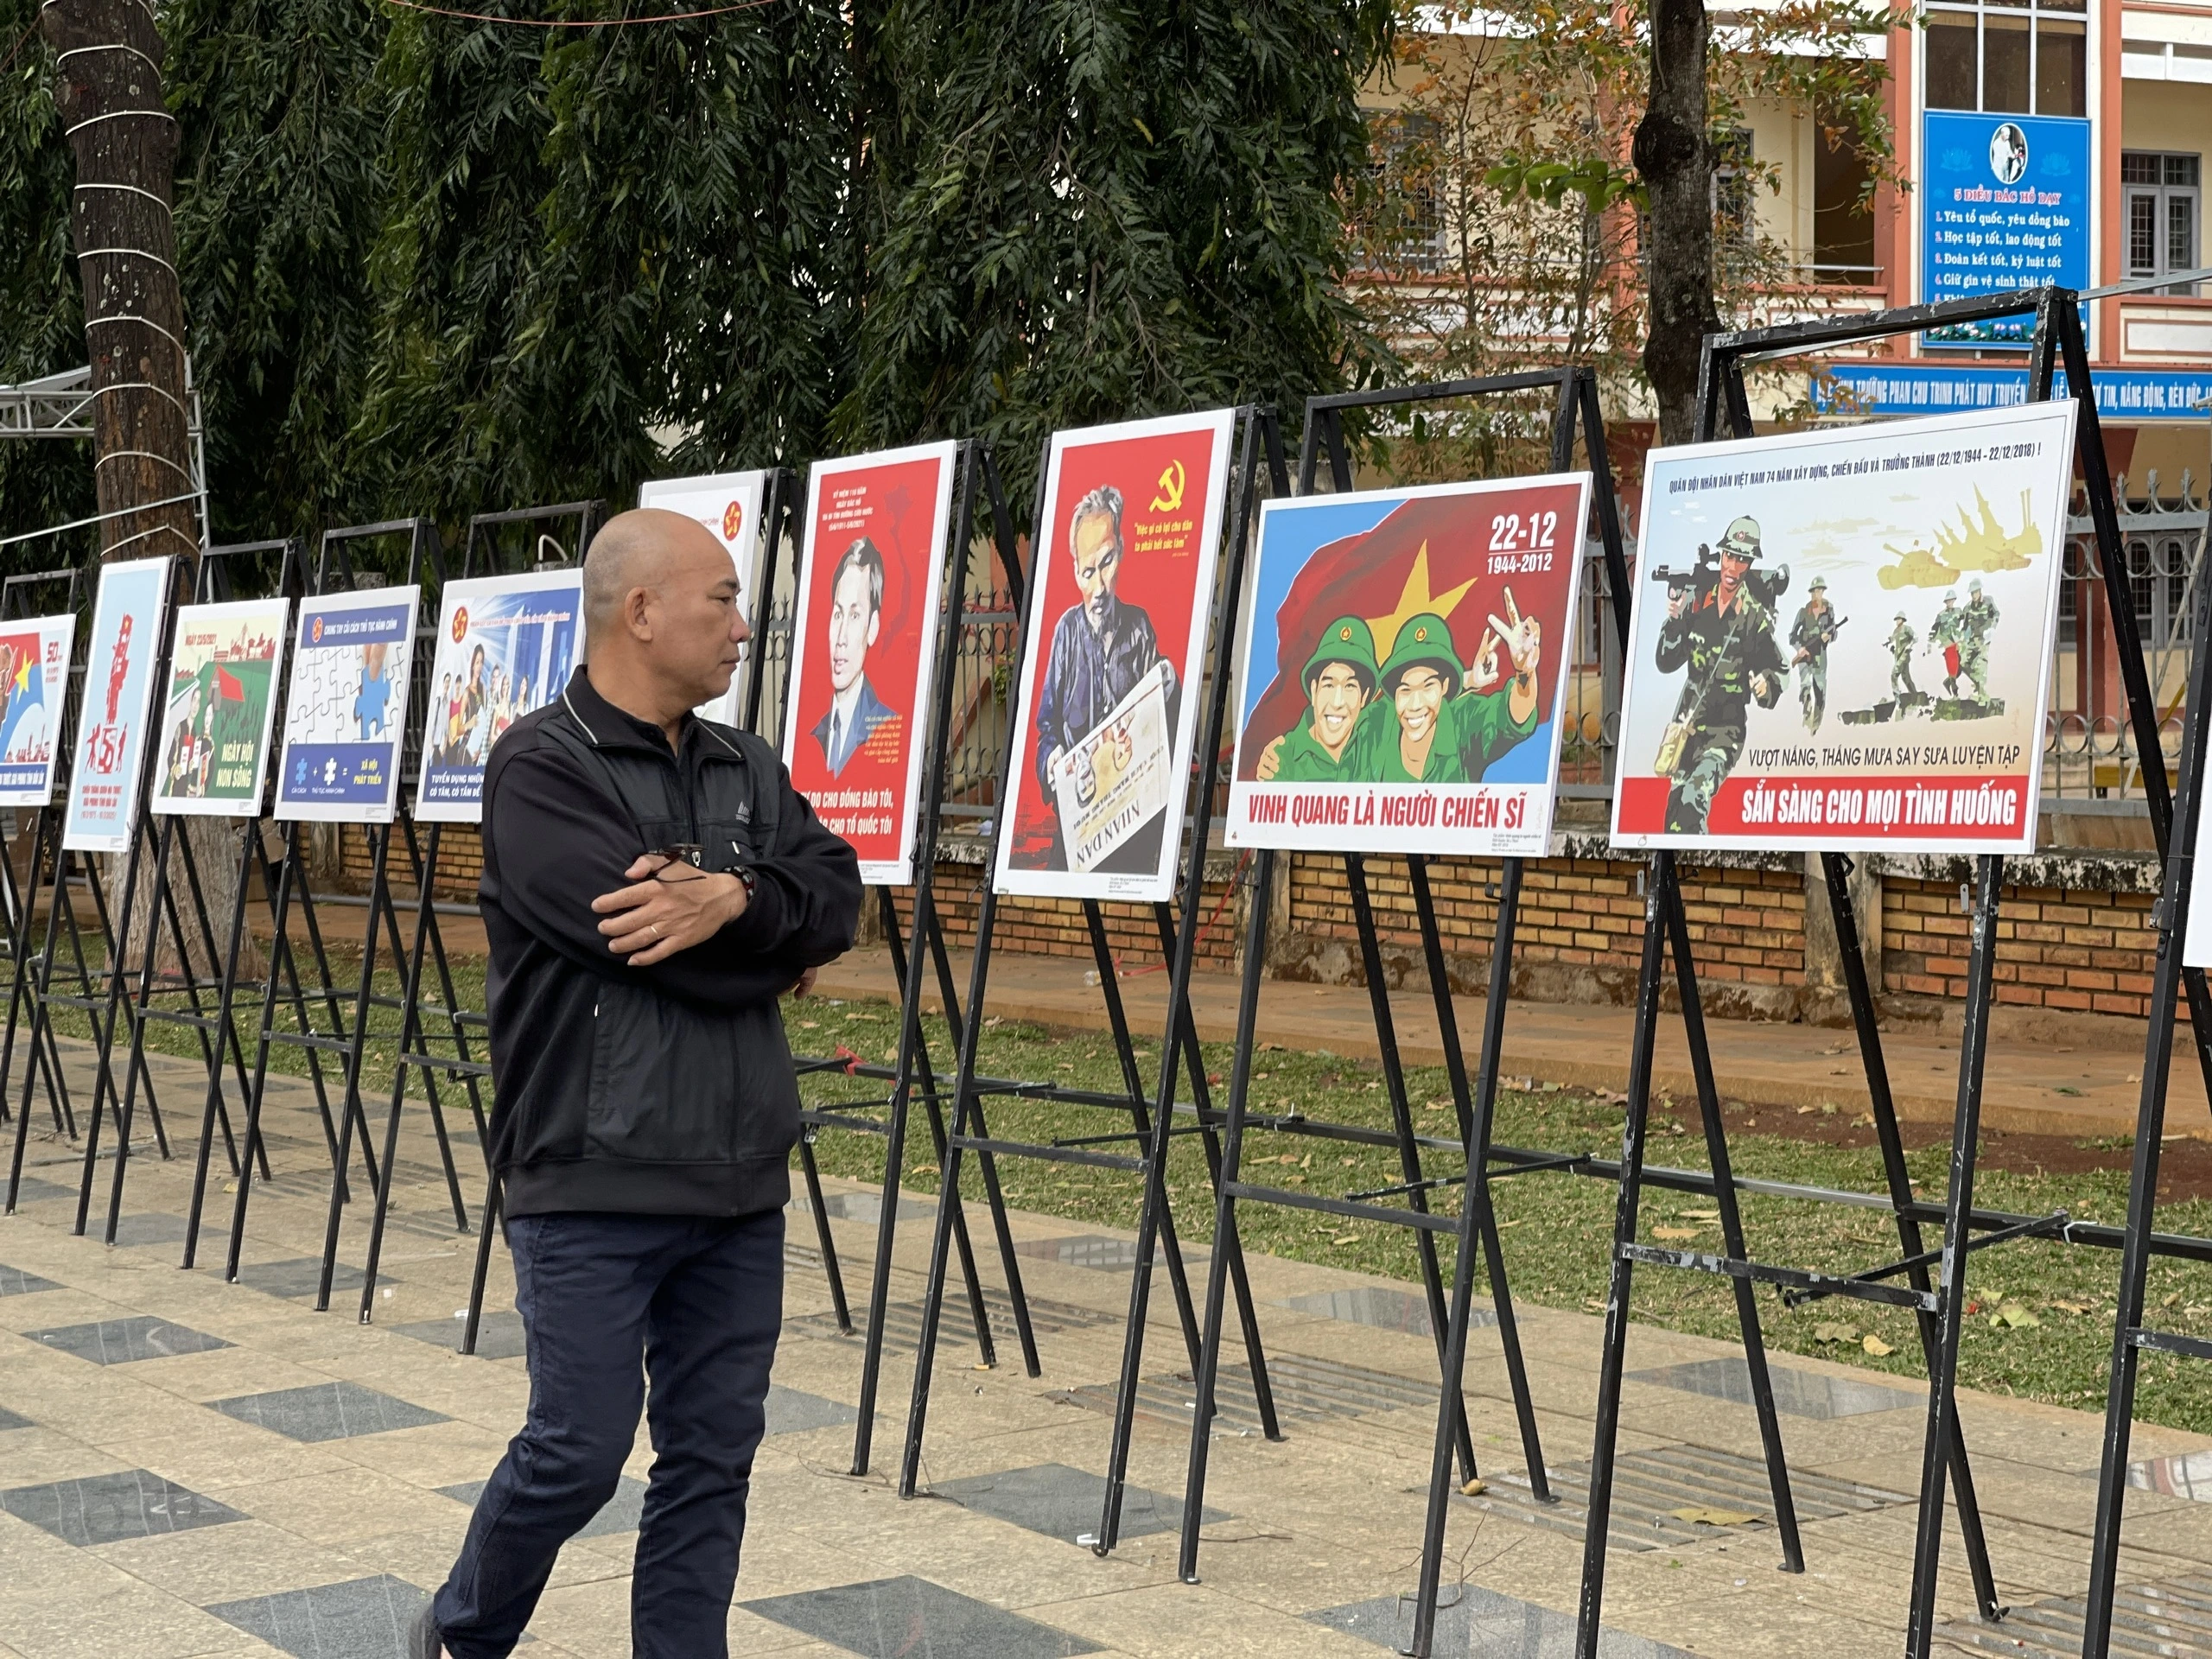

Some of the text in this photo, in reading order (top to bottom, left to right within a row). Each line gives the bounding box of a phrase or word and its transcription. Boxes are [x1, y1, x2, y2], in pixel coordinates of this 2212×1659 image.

[1954, 188, 1962, 201] 5
[1994, 188, 2018, 203] BÁC
[2019, 185, 2036, 204] HỒ
[1936, 211, 1942, 222] 1.
[1944, 211, 1963, 223] Yêu
[1966, 208, 1976, 223] tổ
[1979, 210, 2005, 226] quốc,
[2008, 213, 2026, 227] yêu
[2053, 214, 2070, 226] bào
[1935, 231, 1942, 243] 2.
[1944, 231, 1963, 245] Học
[1966, 232, 1983, 247] tập
[1986, 231, 2003, 246] tốt,
[2005, 232, 2020, 245] lao
[2048, 232, 2063, 247] tốt
[1944, 252, 1969, 264] Đoàn
[1972, 251, 1988, 265] kết
[1991, 252, 2009, 267] tốt,
[2026, 255, 2044, 270] luật
[2047, 254, 2062, 268] tốt
[1943, 273, 1962, 285] Giữ
[1981, 274, 1993, 289] vệ
[1995, 274, 2016, 287] sinh
[1889, 380, 1910, 404] PHAN
[1912, 381, 1928, 404] CHU
[1930, 381, 1953, 405] TRINH
[1955, 378, 1976, 405] PHÁT
[1977, 383, 1993, 405] HUY
[2104, 385, 2118, 410] TIN,
[2120, 381, 2142, 409] NĂNG
[2143, 380, 2166, 413] ĐỘNG,
[2168, 381, 2184, 408] RÈN
[1669, 479, 1686, 494] QUÂN
[1688, 478, 1699, 494] ĐỘI
[1700, 475, 1718, 491] NHÂN
[1719, 473, 1732, 488] DÂN
[1733, 471, 1749, 490] VIỆT
[1750, 471, 1765, 486] NAM
[1766, 471, 1776, 483] 74
[1777, 467, 1792, 482] NĂM
[1794, 465, 1808, 480] XÂY
[1809, 463, 1830, 482] DỰNG,
[1831, 459, 1853, 477] CHIẾN
[1853, 456, 1868, 474] ĐẤU
[1870, 457, 1880, 473] VÀ
[1882, 451, 1910, 472] TRƯỞNG
[1911, 451, 1936, 469] THÀNH
[1936, 448, 1982, 467] (22/12/1944
[1989, 442, 2036, 461] 22/12/2018)
[1489, 511, 1557, 551] 22-12
[1487, 552, 1553, 575] 1944-2012
[221, 740, 241, 762] NGÀY
[240, 740, 254, 766] HỘI
[1749, 748, 1780, 772] VƯỢT
[1864, 747, 1893, 766] MƯA
[1896, 747, 1921, 766] SAY
[1923, 746, 1949, 766] SƯA
[1952, 744, 1994, 771] LUYỆN
[1998, 744, 2020, 770] TẬP
[216, 765, 251, 788] NON SÔNG
[467, 772, 485, 784] NHỮN
[823, 791, 838, 809] CHO
[862, 788, 878, 809] BÀO
[880, 788, 893, 810] TÔI,
[1249, 787, 1528, 830] VINH QUANG LÀ NGƯỜI CHIẾN SĨ
[1741, 779, 2018, 832] SẴN SÀNG CHO MỌI TÌNH HUỐNG
[830, 818, 845, 835] CHO
[846, 812, 858, 835] TỔ
[857, 812, 879, 836] QUỐC
[880, 815, 893, 835] TÔI
